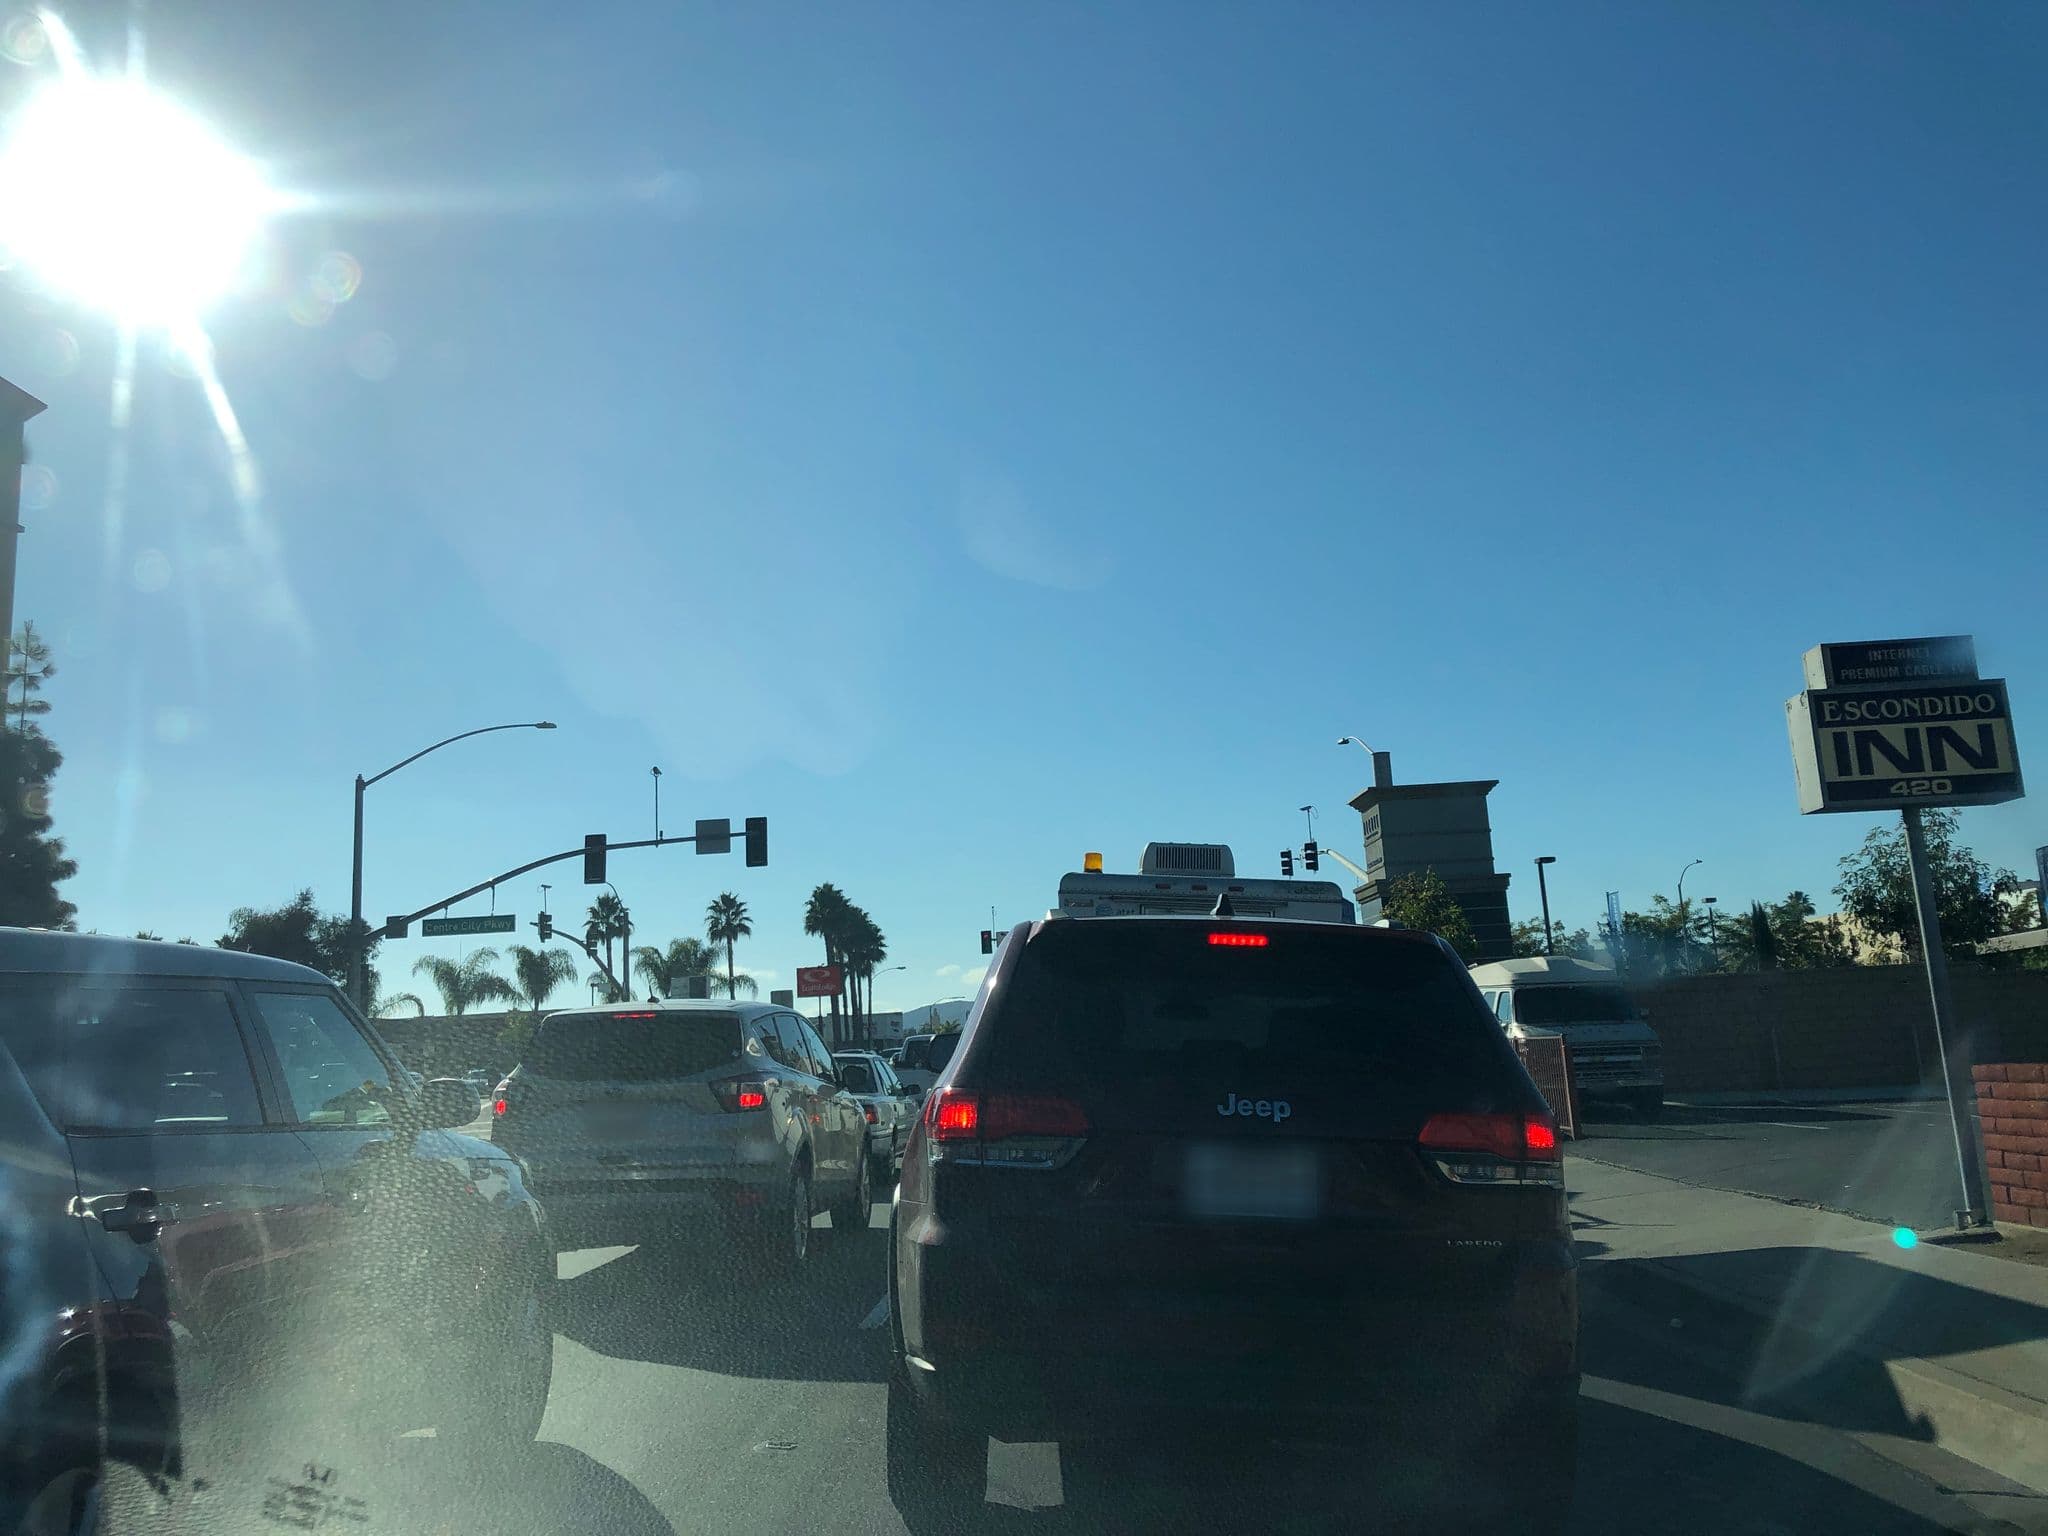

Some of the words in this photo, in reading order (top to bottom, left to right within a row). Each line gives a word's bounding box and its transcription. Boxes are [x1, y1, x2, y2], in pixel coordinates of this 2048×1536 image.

[1840, 665, 1900, 680] PREMIUM
[1904, 663, 1945, 677] CABLE
[1822, 693, 1996, 722] ESCONDIDO
[1831, 723, 2000, 777] INN
[1889, 778, 1953, 796] 420
[425, 922, 457, 933] Centre
[461, 920, 482, 932] City
[1217, 1093, 1292, 1122] Jeep
[1447, 1239, 1503, 1249] LAREDO
